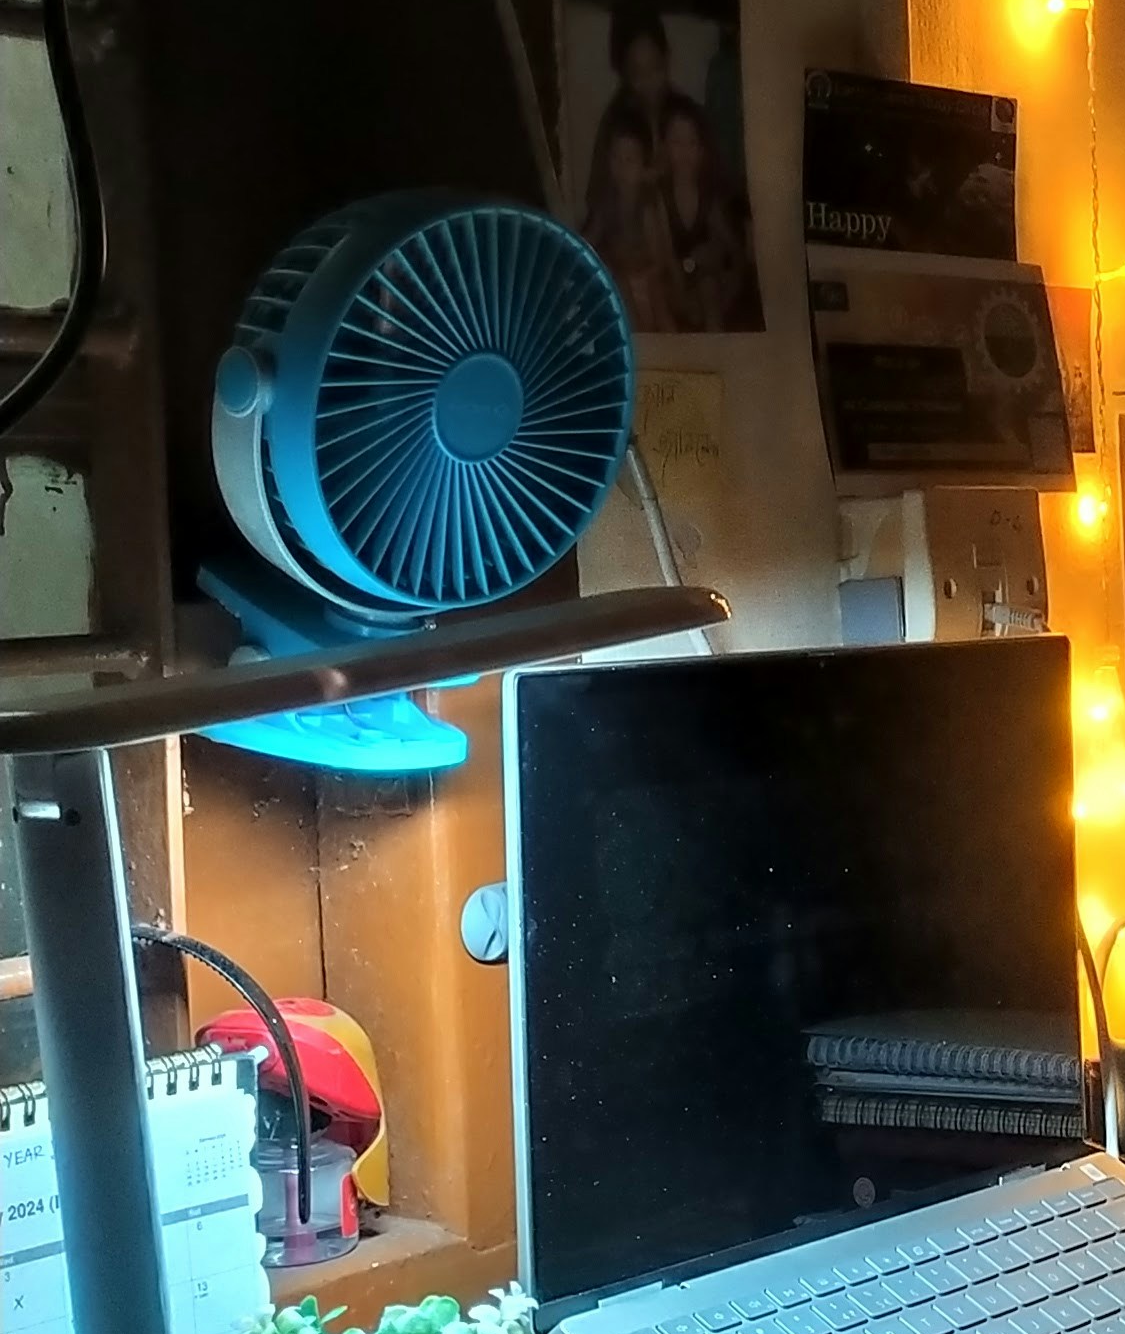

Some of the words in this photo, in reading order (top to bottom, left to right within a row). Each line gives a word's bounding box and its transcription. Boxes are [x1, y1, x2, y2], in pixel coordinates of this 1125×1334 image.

[804, 200, 893, 243] Happy
[3, 1144, 45, 1168] YEAR
[7, 1198, 44, 1221] 2024
[197, 1281, 209, 1292] 13
